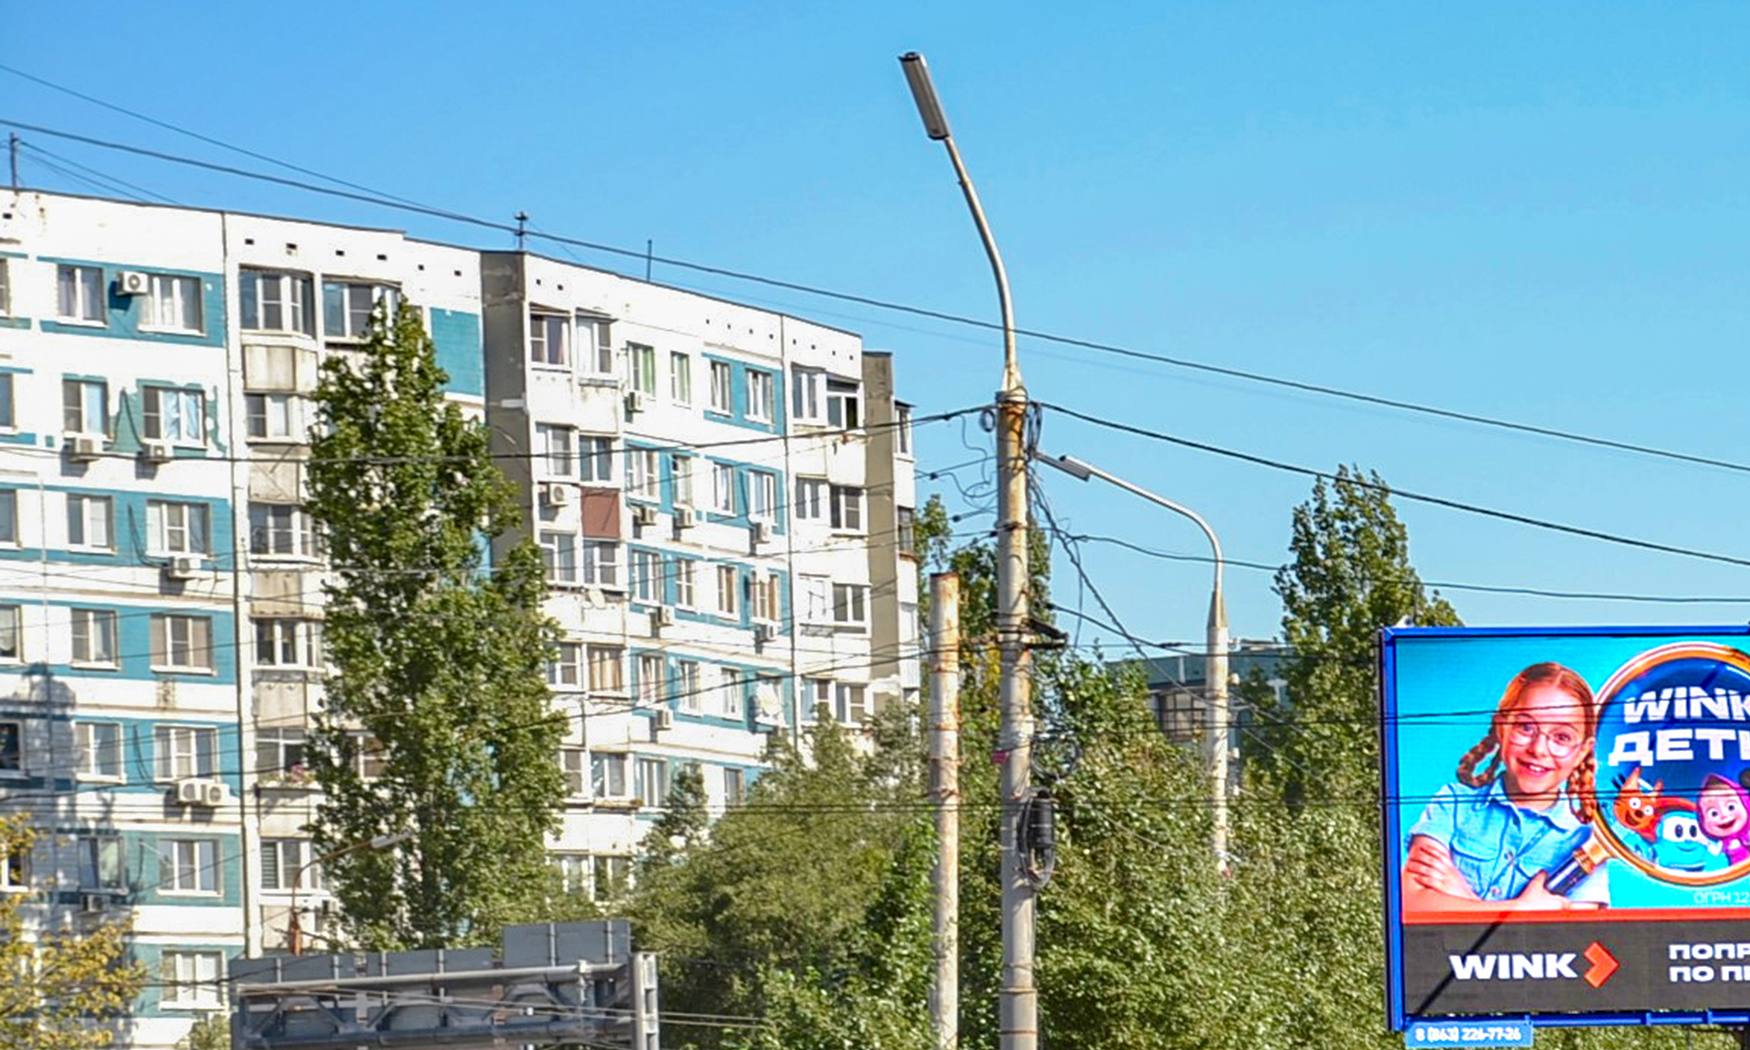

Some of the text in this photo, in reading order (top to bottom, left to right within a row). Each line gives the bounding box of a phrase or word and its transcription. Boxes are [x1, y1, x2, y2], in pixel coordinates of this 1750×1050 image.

[1449, 953, 1579, 980] WINK
[1669, 965, 1715, 982] ПО
[1415, 1027, 1425, 1042] 8
